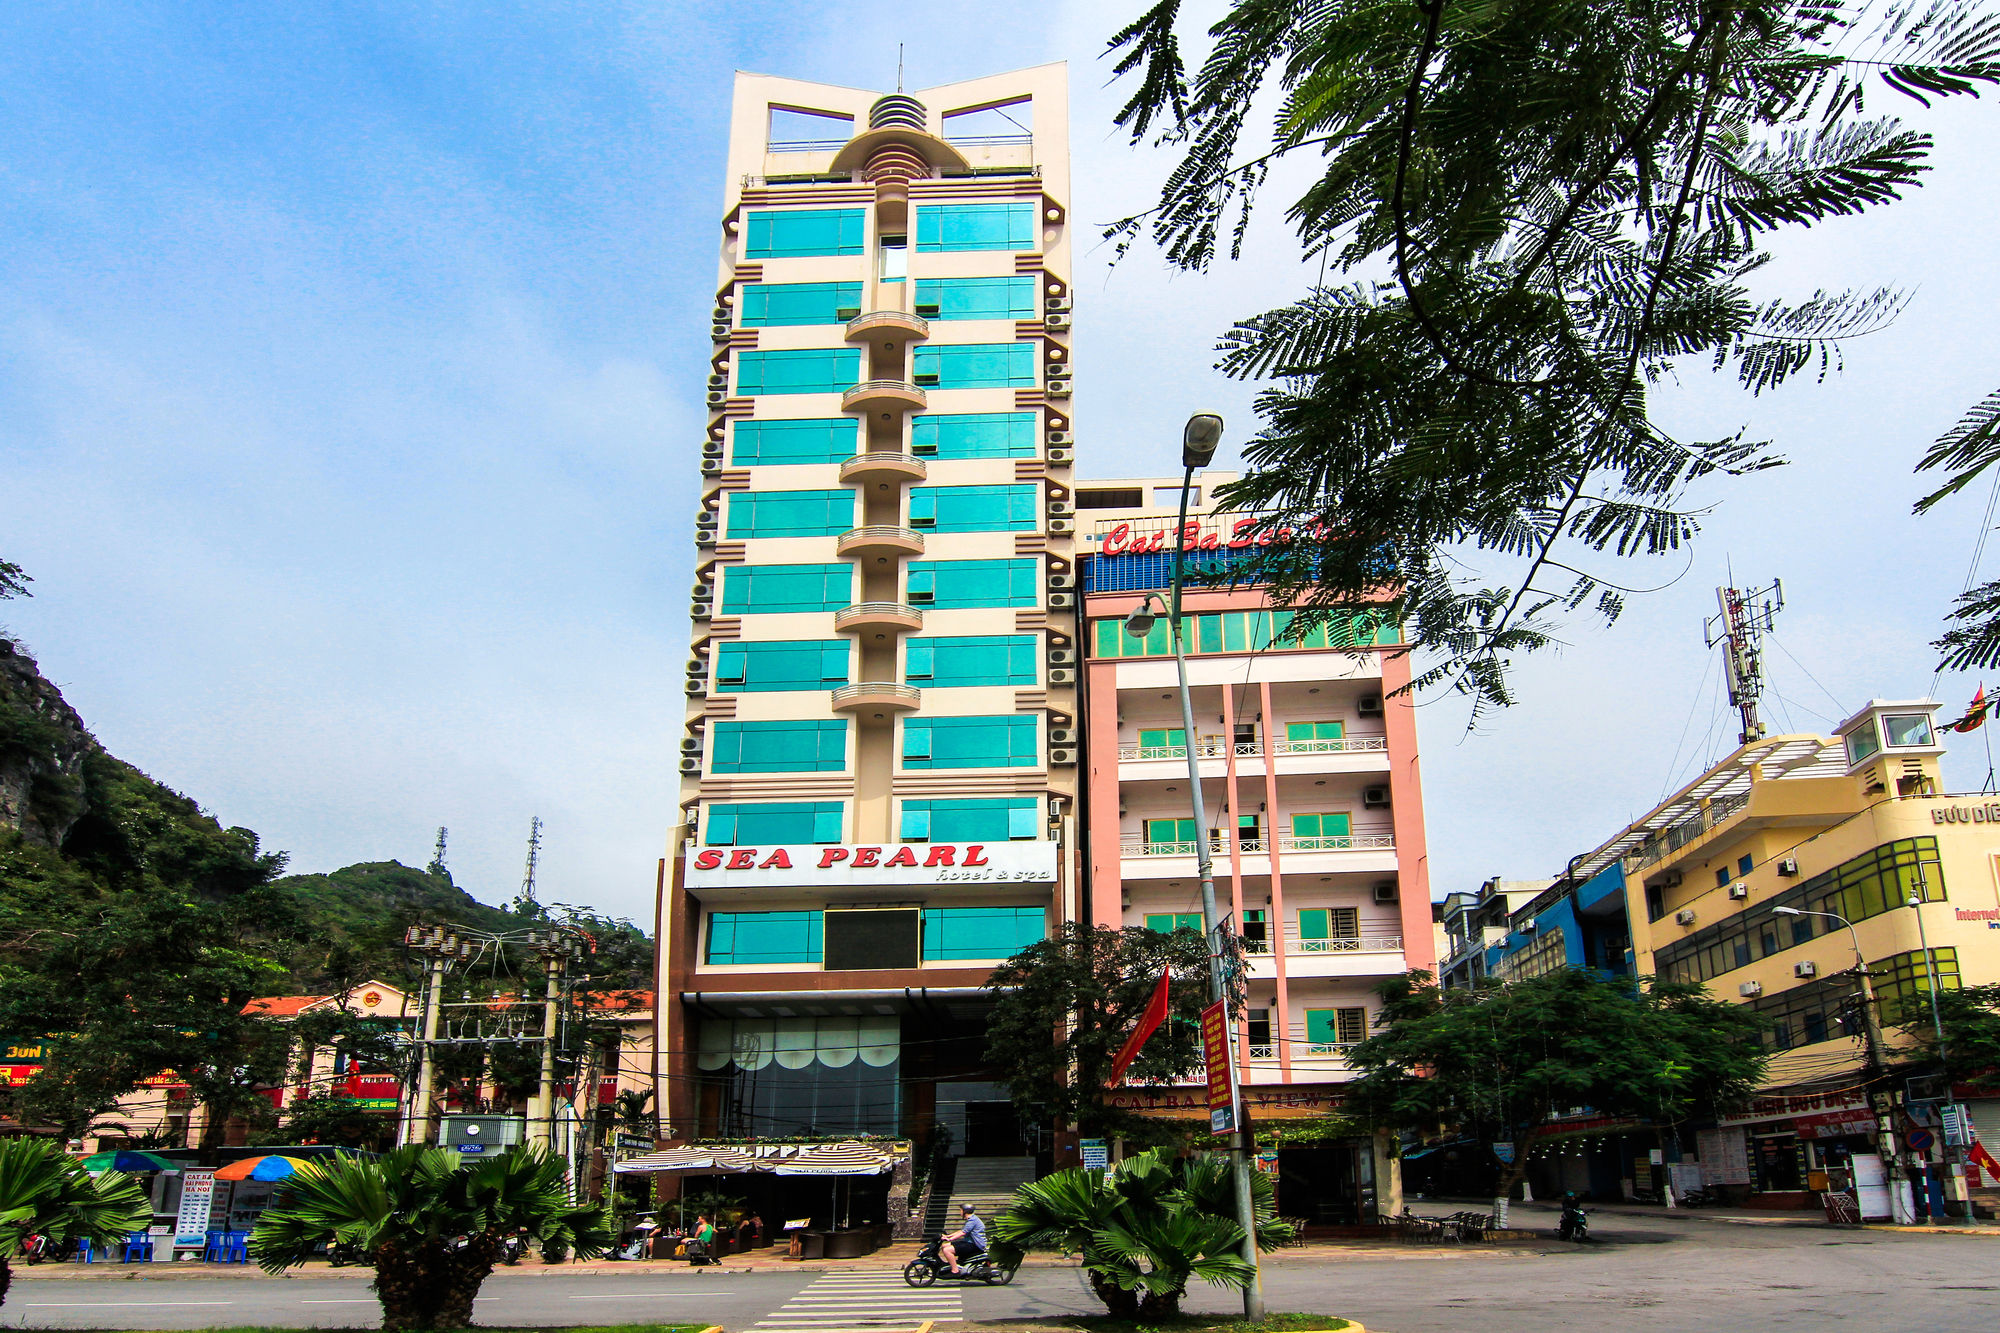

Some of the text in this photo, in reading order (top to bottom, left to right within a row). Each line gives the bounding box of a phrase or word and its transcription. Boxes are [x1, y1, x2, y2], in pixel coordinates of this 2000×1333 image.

[1102, 523, 1165, 555] Cat
[1172, 521, 1220, 551] Ba
[694, 845, 990, 870] SEA PEARL
[935, 867, 1051, 883] hotel & spa
[1111, 1095, 1159, 1112] CAT
[1164, 1095, 1199, 1112] BA
[1254, 1092, 1323, 1110] VIEW
